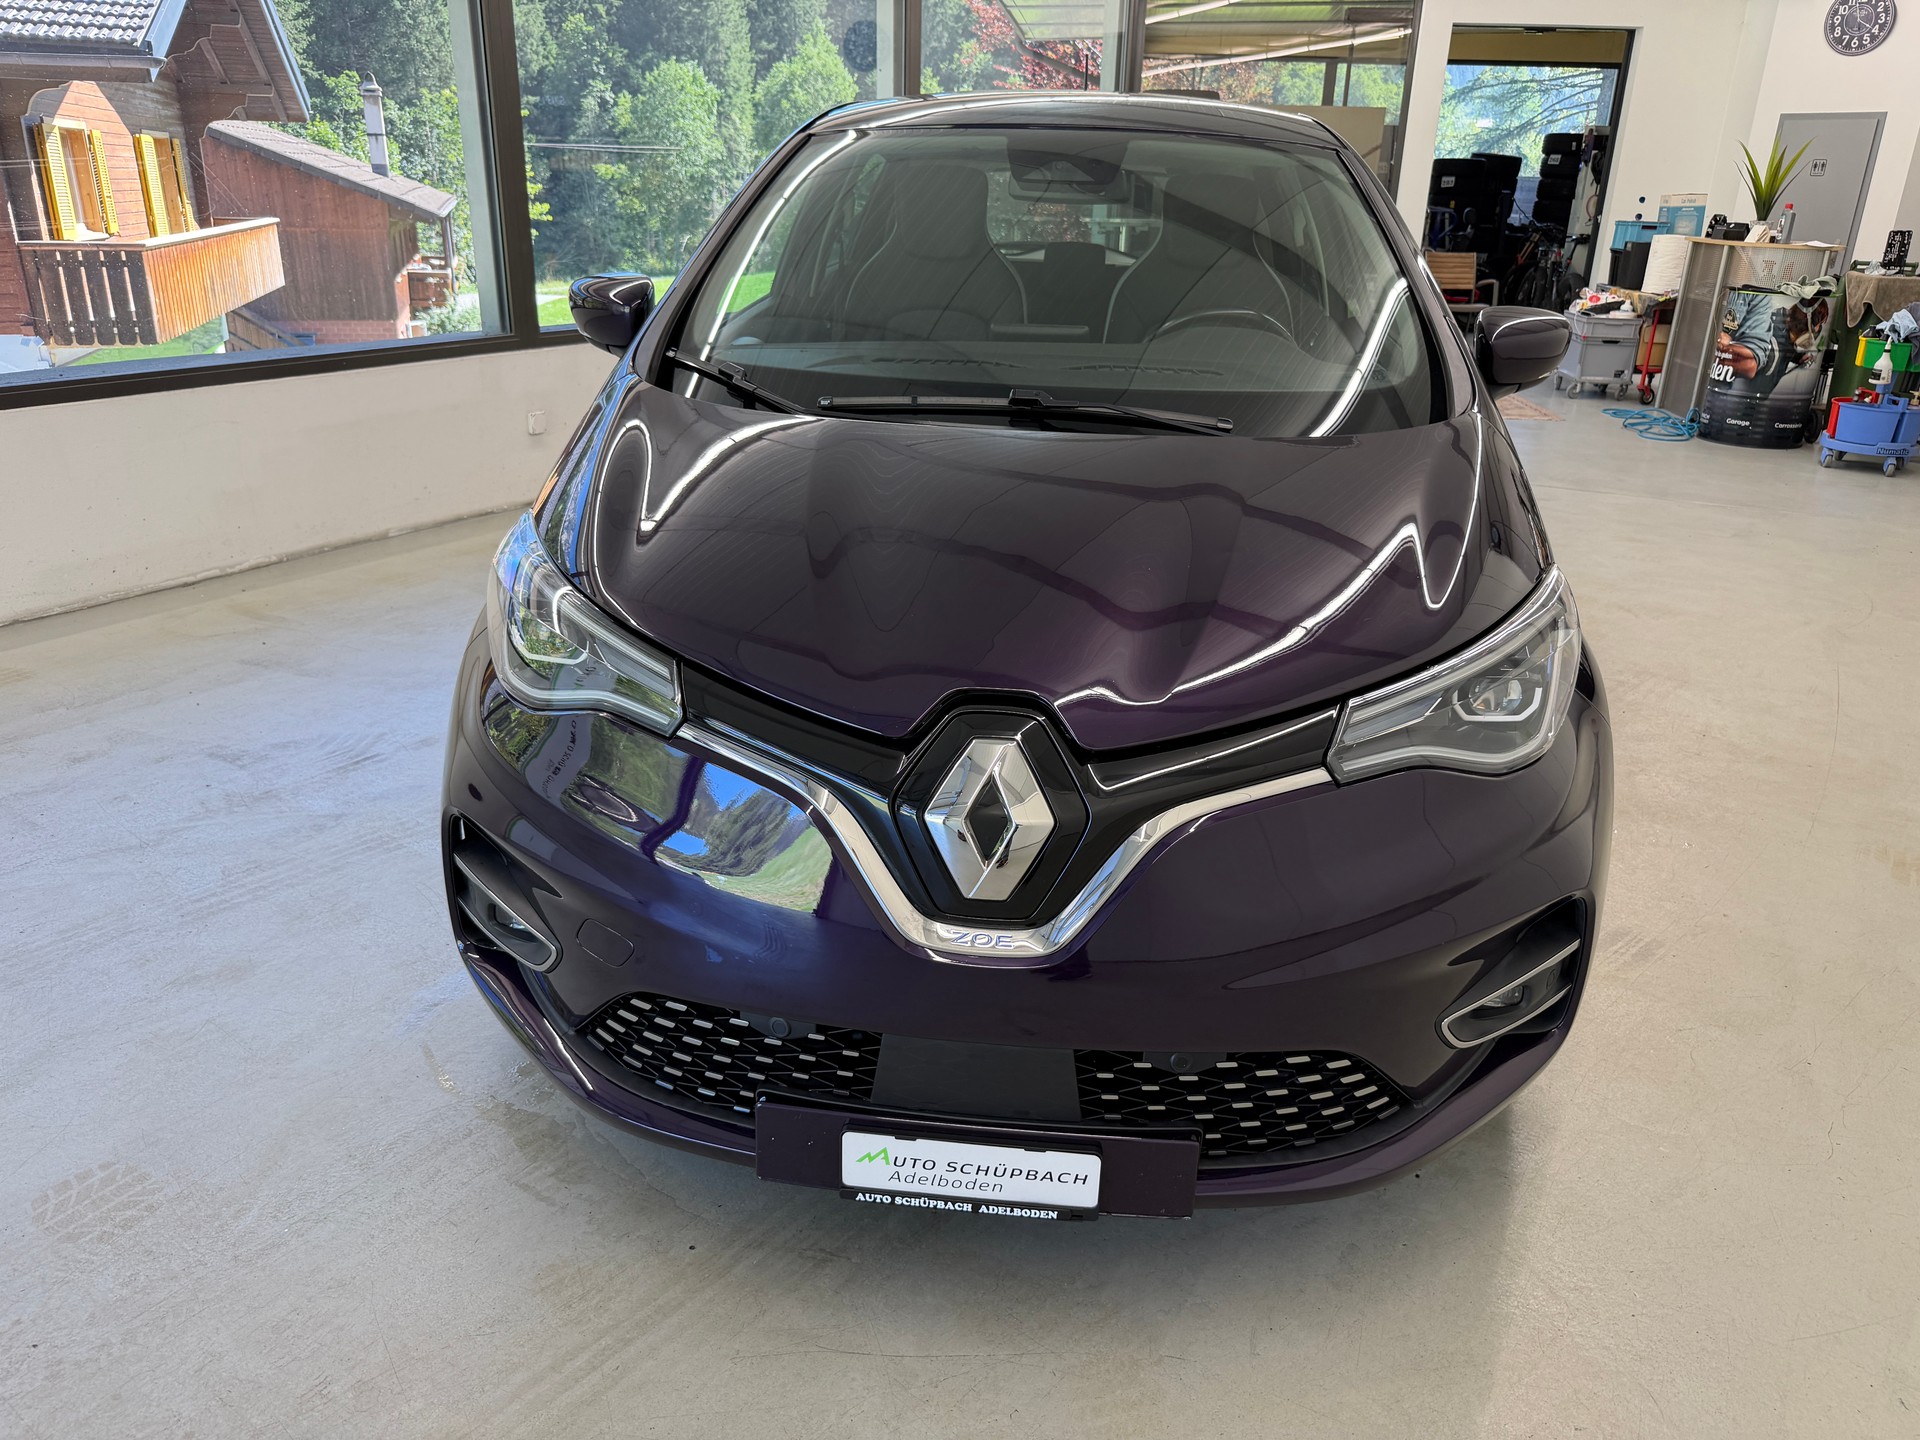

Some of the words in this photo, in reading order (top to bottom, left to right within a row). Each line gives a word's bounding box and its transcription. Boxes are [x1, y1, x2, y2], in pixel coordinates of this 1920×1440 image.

[1838, 5, 1848, 15] 10
[1877, 2, 1884, 11] 2
[1834, 16, 1841, 26] 9
[1878, 13, 1885, 23] 3
[1834, 27, 1841, 37] 8
[1872, 25, 1879, 35] 4
[1842, 35, 1849, 46] 7
[1851, 37, 1858, 47] 6
[1863, 34, 1870, 45] 5
[1726, 418, 1750, 426] Garage
[1876, 447, 1910, 456] Numatic
[950, 930, 1015, 949] ZOE
[945, 1160, 1089, 1186] SCHÜPBACH
[888, 1169, 1004, 1193] Adelboden
[855, 1192, 892, 1204] AUTO
[894, 1195, 973, 1213] SCHÜPBACH
[978, 1204, 1059, 1220] ADELBODEN
